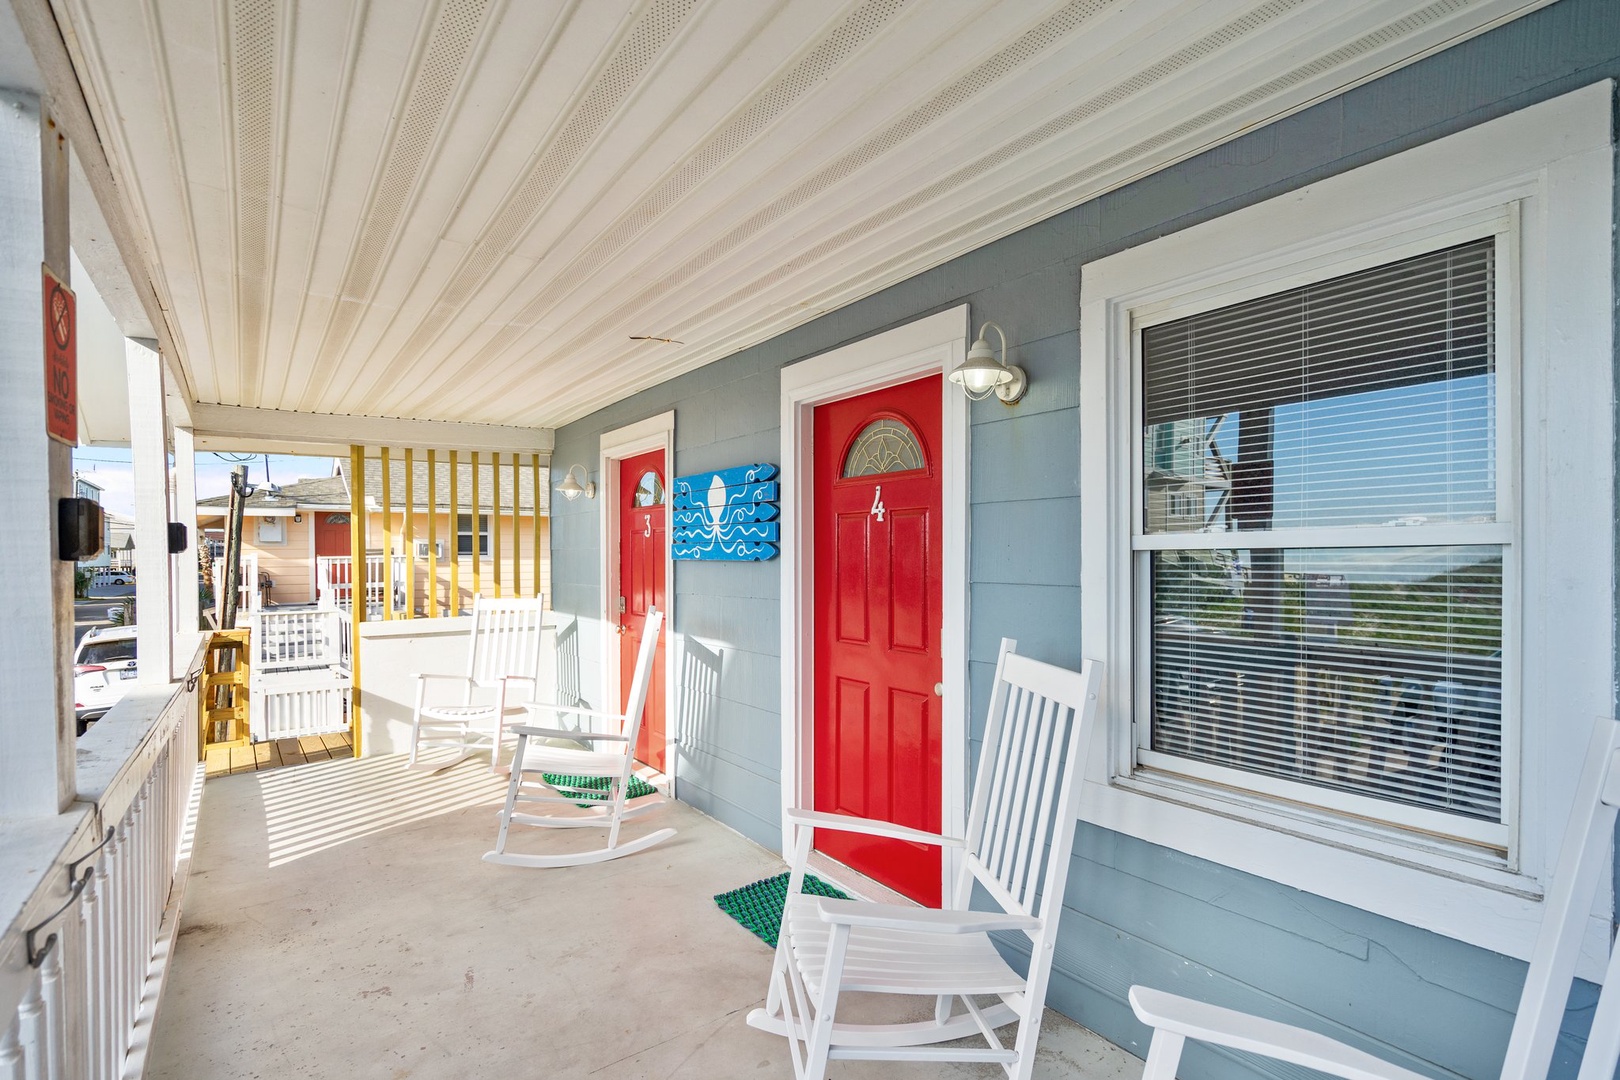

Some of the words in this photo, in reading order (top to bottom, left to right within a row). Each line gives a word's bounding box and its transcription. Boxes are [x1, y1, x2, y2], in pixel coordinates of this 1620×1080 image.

[53, 364, 69, 399] NO
[870, 485, 886, 522] 4
[644, 514, 651, 538] 3
